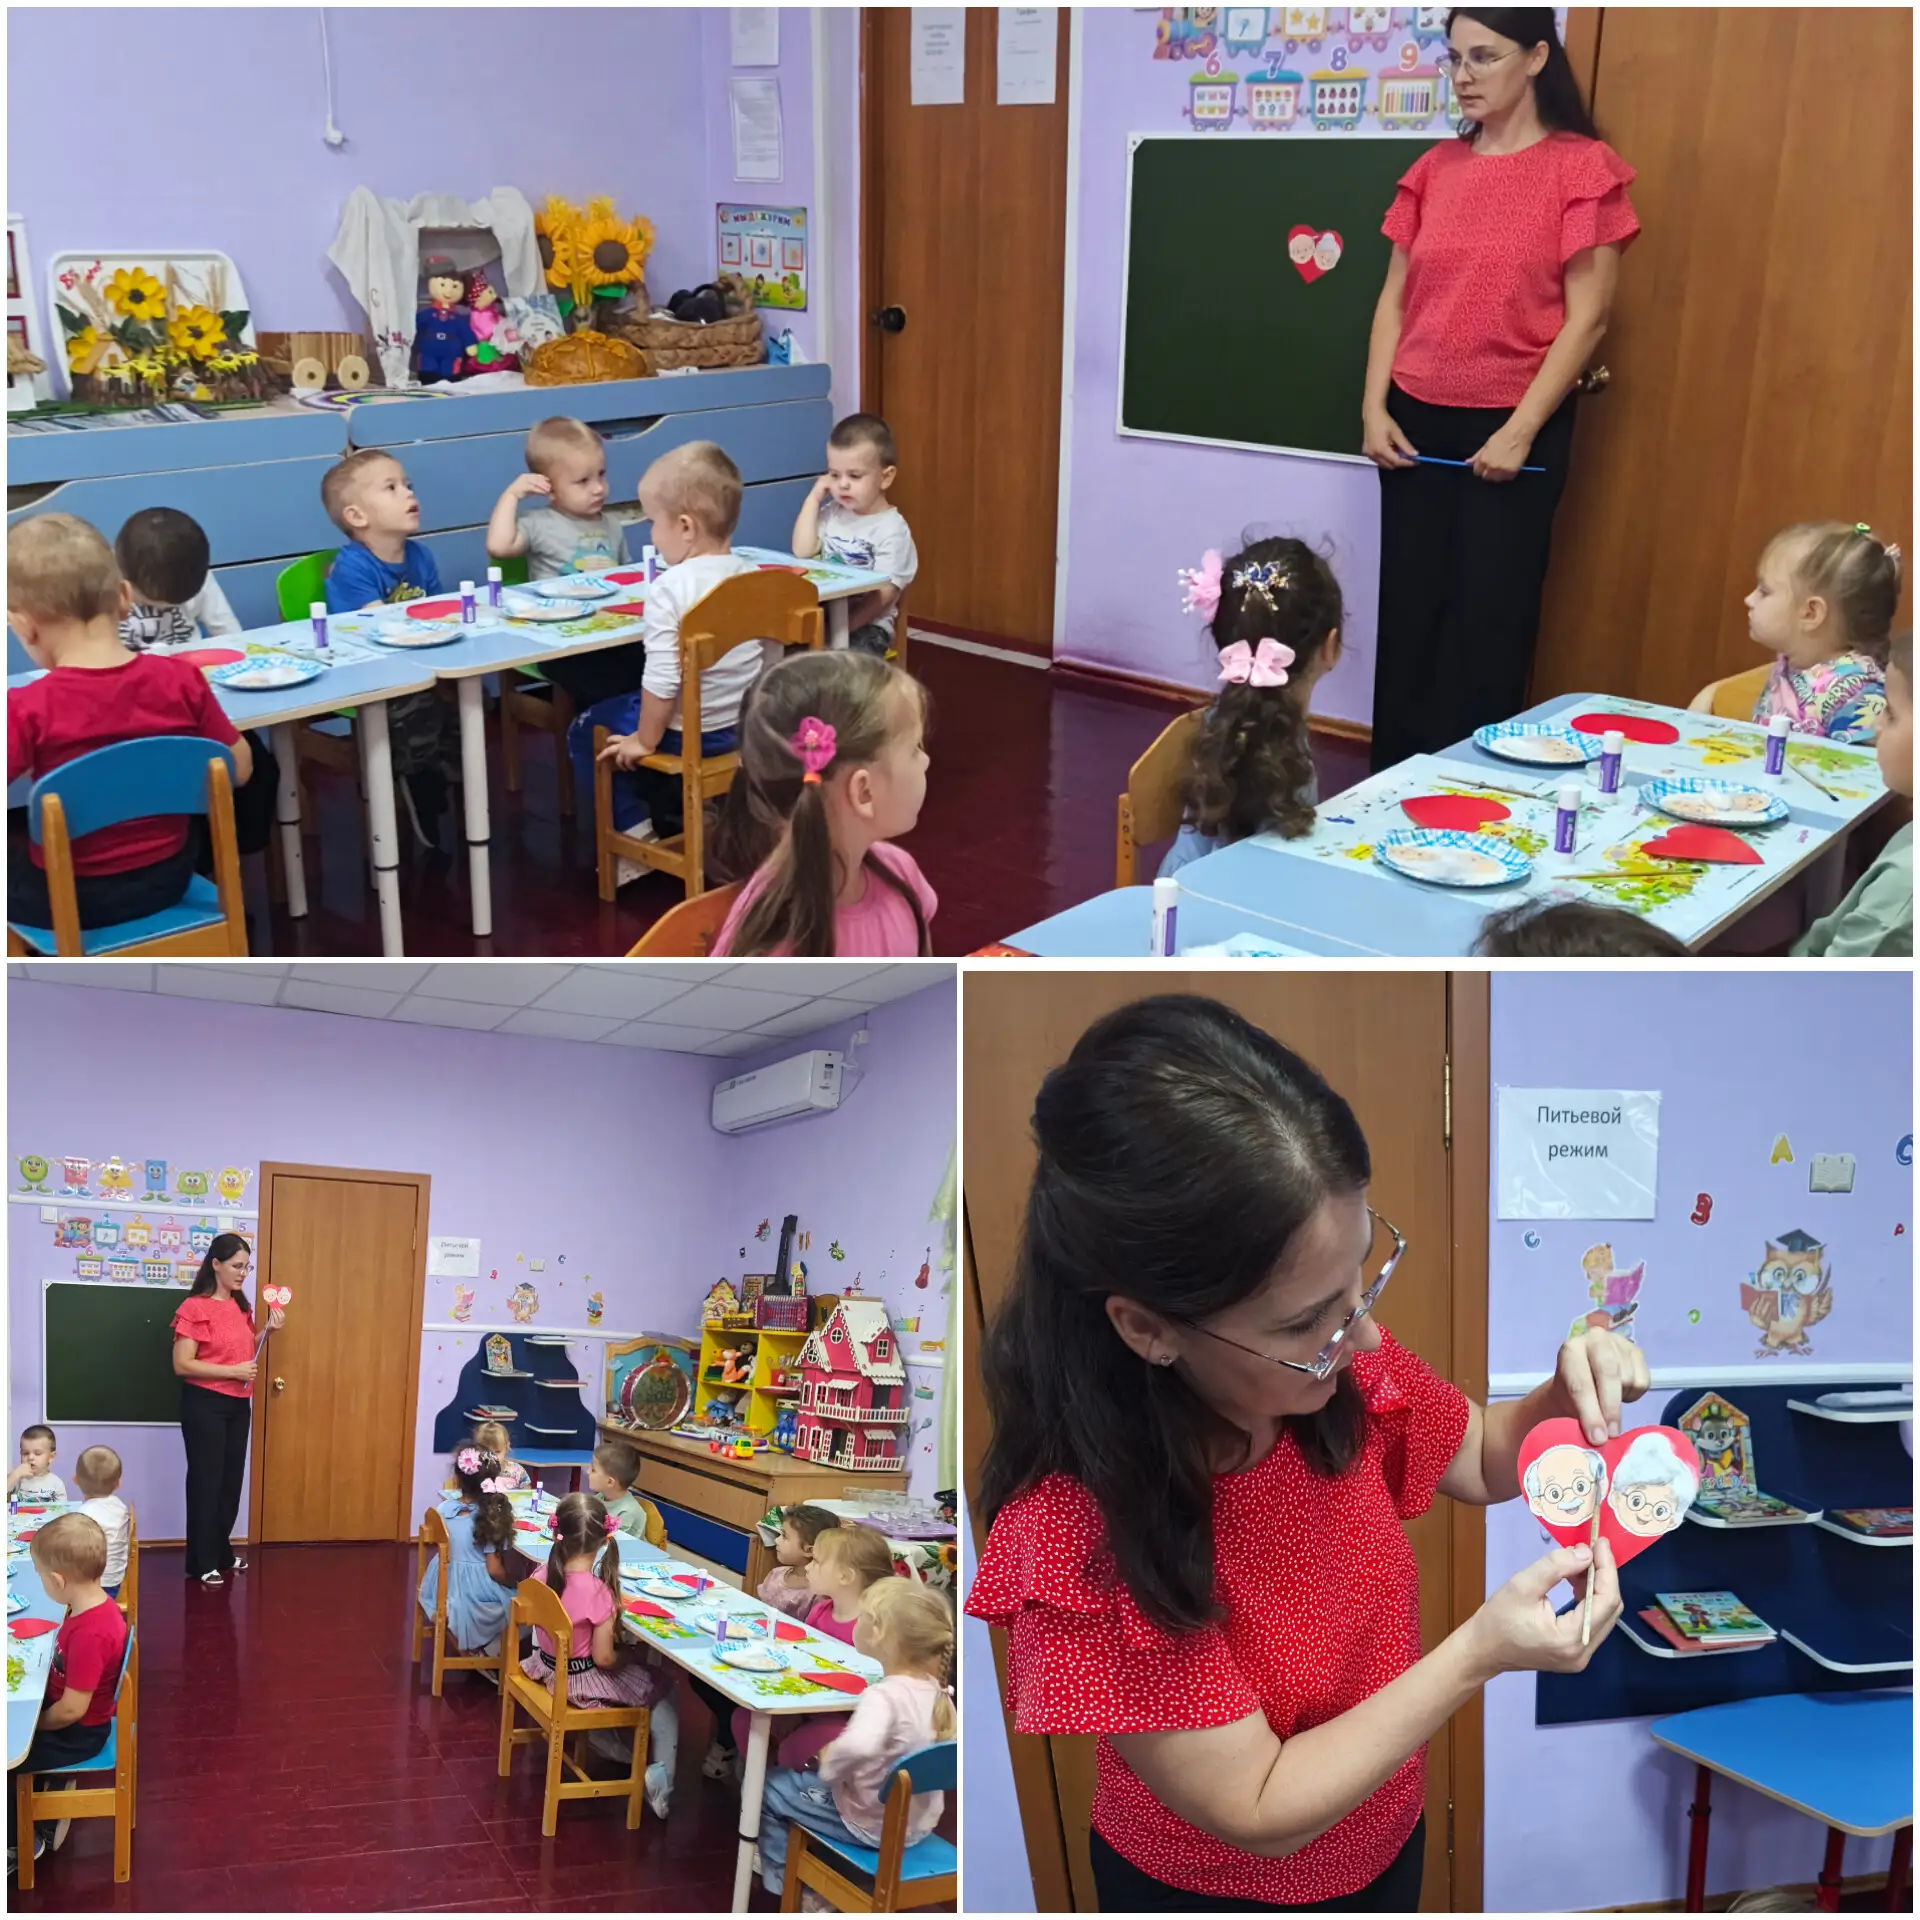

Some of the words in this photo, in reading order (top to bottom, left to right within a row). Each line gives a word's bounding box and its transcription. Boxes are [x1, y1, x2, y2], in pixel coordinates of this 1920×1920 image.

[1205, 51, 1221, 75] 6
[1265, 50, 1284, 78] 7
[1331, 46, 1348, 72] 8
[1400, 43, 1419, 70] 9
[1537, 1105, 1622, 1125] Питьевой
[1548, 1143, 1609, 1162] режим
[133, 1213, 143, 1225] 2
[166, 1215, 175, 1226] 3
[199, 1217, 208, 1229] 4
[238, 1222, 247, 1233] 5
[85, 1246, 94, 1257] 6
[152, 1250, 161, 1260] 8
[186, 1251, 196, 1261] 9
[568, 1657, 593, 1672] OVE
